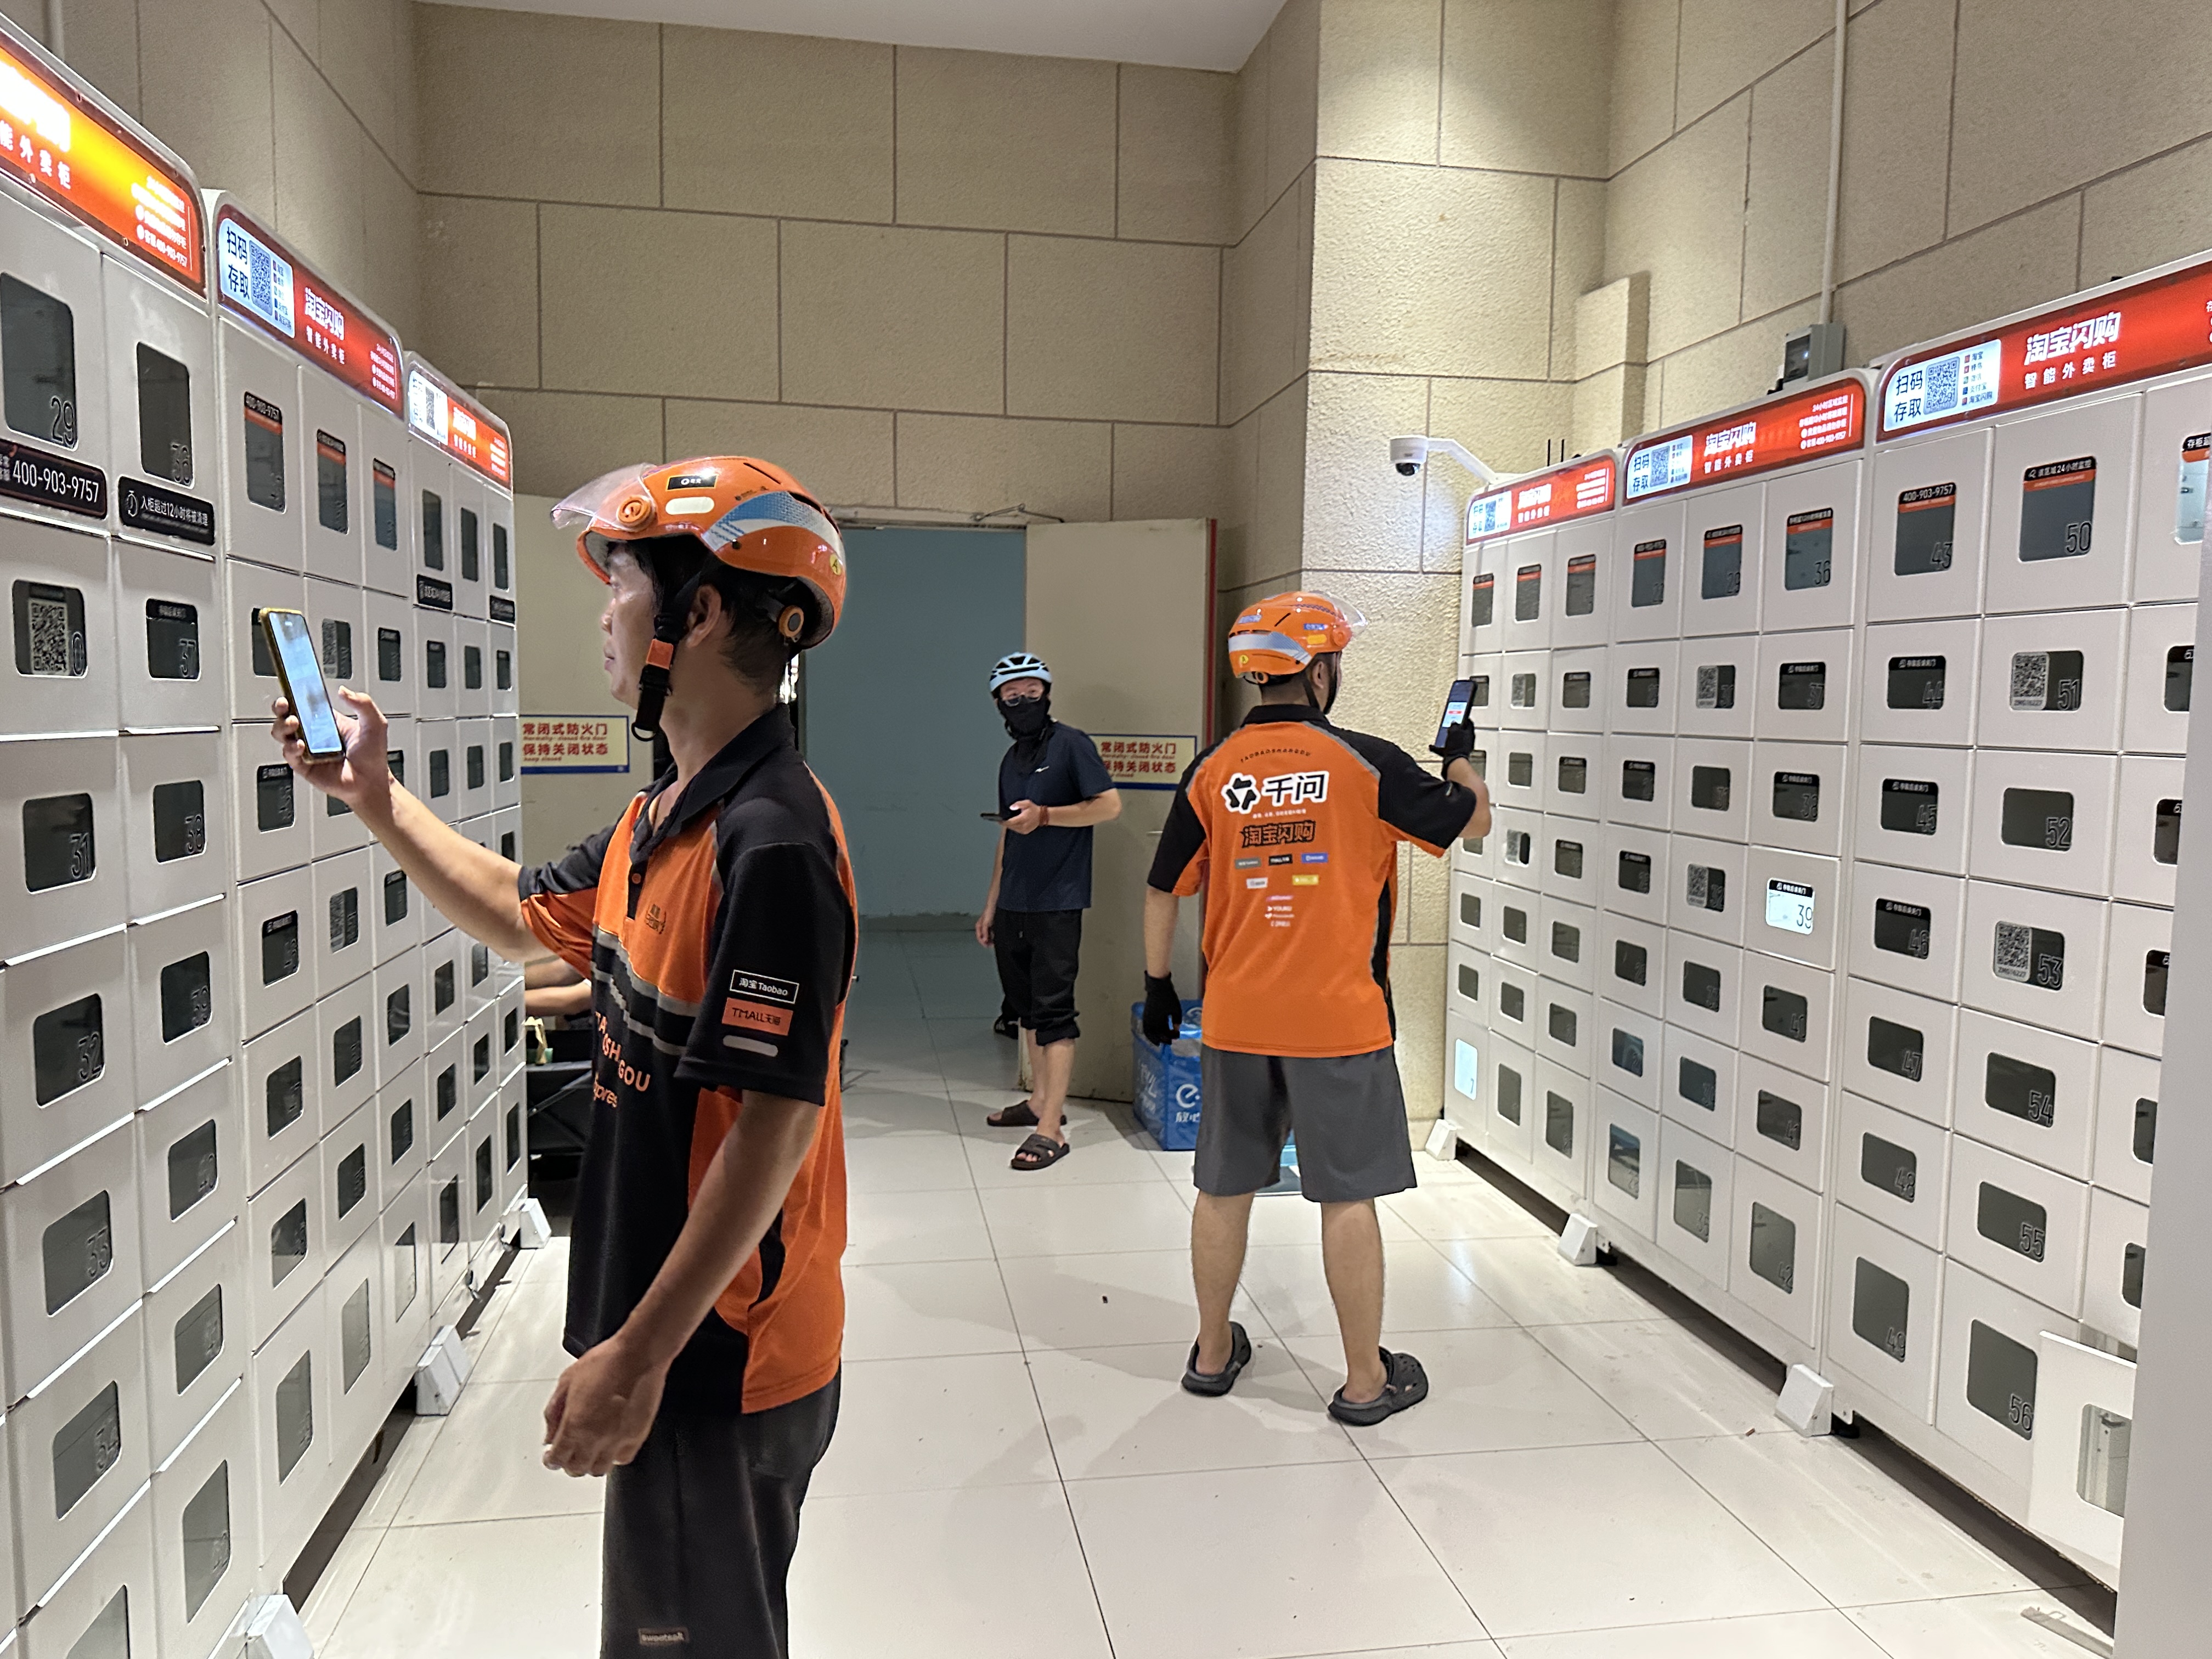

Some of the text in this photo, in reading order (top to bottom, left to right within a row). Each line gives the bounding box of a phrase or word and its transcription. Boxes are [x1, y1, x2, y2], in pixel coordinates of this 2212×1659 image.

[227, 226, 248, 265] 扫码
[228, 264, 250, 300] 存取
[304, 287, 345, 341] 淘宝闪购
[306, 325, 345, 365] 智能外卖柜
[2023, 311, 2121, 366] 淘宝闪购
[1895, 370, 1923, 395] 扫码
[2024, 351, 2117, 390] 智能外卖柜
[50, 396, 75, 445] 29
[1894, 398, 1921, 422] 存取
[1704, 421, 1757, 457] 淘宝闪购
[1634, 453, 1649, 472] 扫码
[13, 460, 99, 503] 400-903-9757
[1633, 475, 1649, 493] 存取
[1903, 484, 1953, 502] 400-903-9757
[2065, 521, 2092, 555] 50
[1931, 541, 1953, 571] 43
[1813, 560, 1830, 586] 36
[2057, 679, 2080, 710] 51
[523, 723, 607, 735] 常闭式防火门
[522, 743, 608, 755] 保持关闭状态
[1101, 742, 1177, 754] 常闭式防火门
[1264, 772, 1326, 804] 千问
[1242, 820, 1316, 848] 淘宝闪购
[2045, 816, 2072, 849] 52
[69, 832, 91, 878] 31
[1796, 904, 1813, 929] 39
[2037, 953, 2062, 988] 53
[758, 982, 788, 996] Taobao
[732, 1007, 765, 1023] TMALL
[78, 1031, 103, 1080] 32
[1901, 1049, 1922, 1080] 47
[2029, 1090, 2053, 1126] 54
[2018, 1222, 2045, 1261] 55
[1885, 1325, 1906, 1360] 49
[2008, 1393, 2033, 1433] 56
